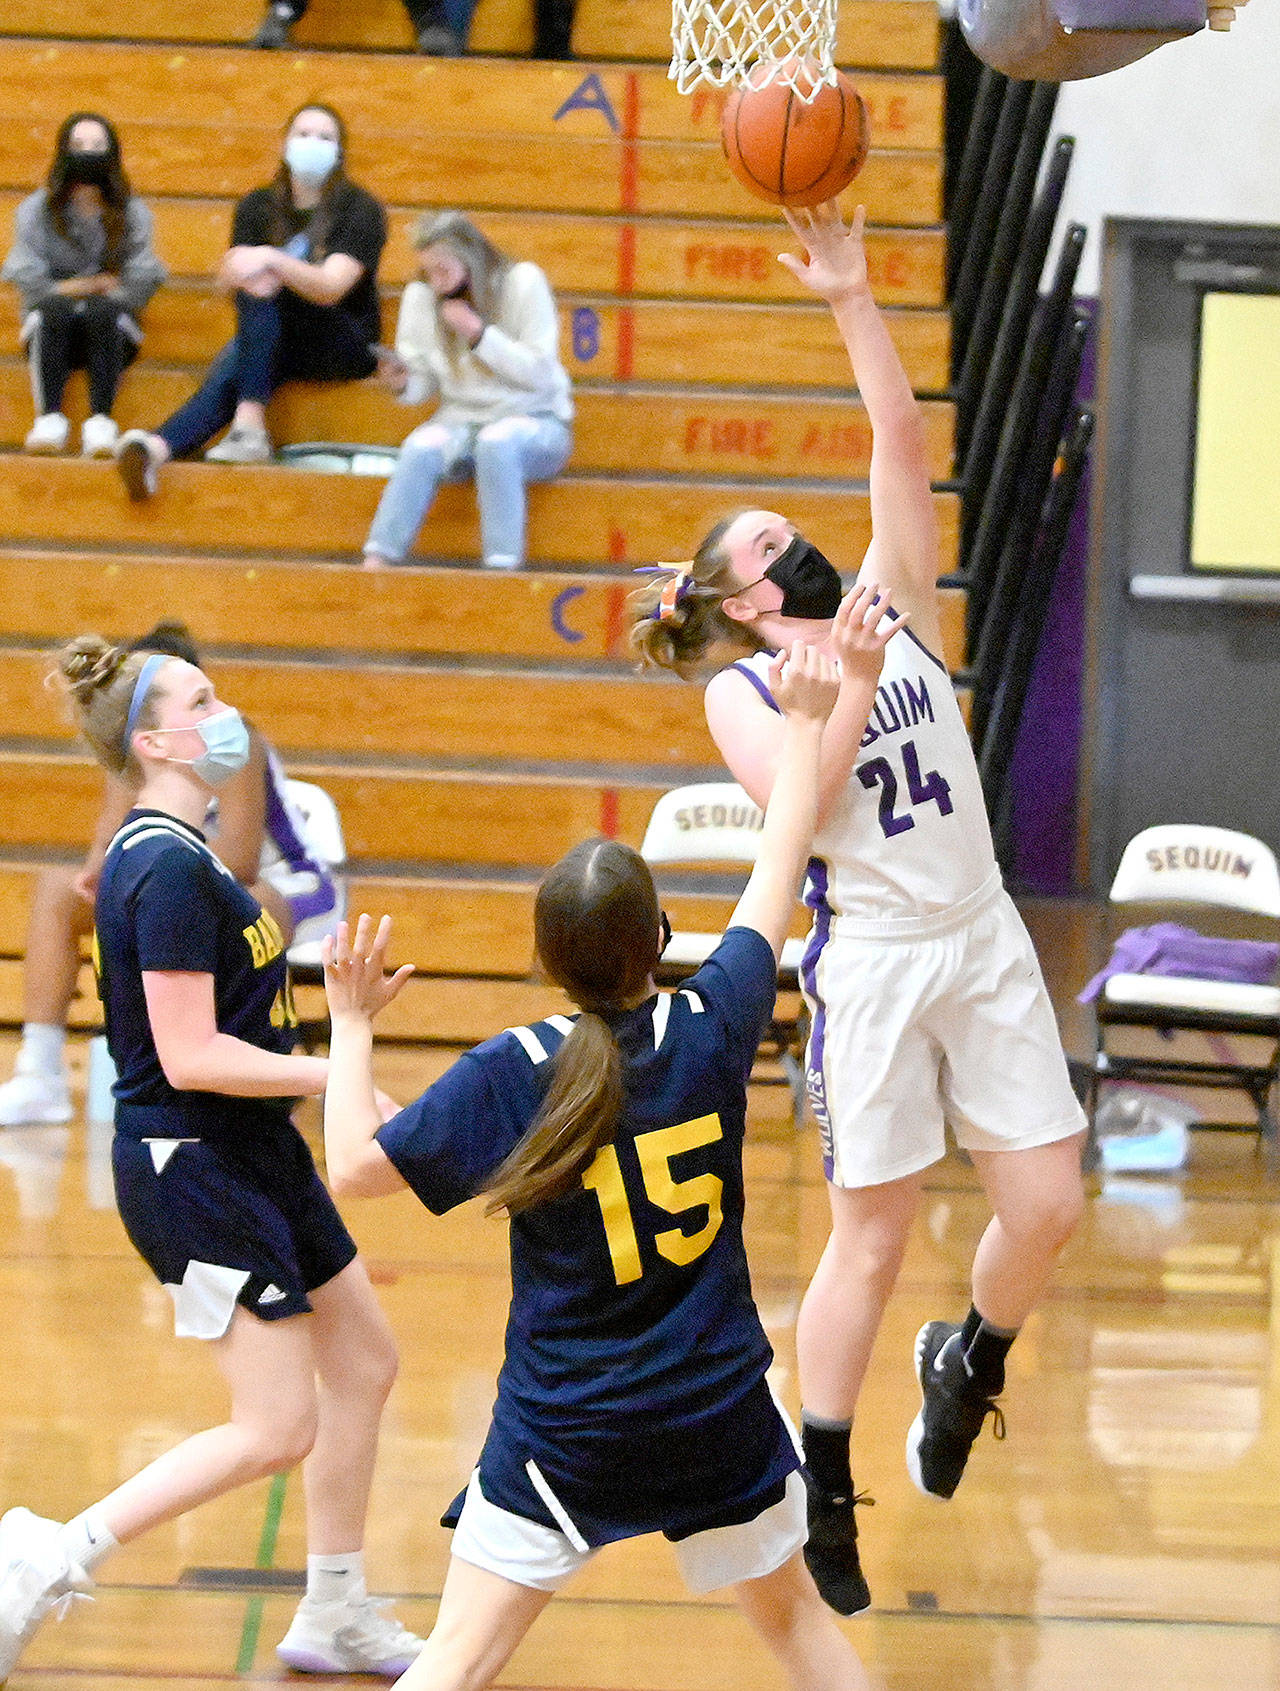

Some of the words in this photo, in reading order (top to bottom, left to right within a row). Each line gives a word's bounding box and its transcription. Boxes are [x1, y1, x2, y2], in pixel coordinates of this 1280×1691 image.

[553, 73, 622, 133] A
[684, 416, 775, 457] FIRE
[801, 422, 873, 459] AIS
[551, 586, 585, 643] C
[856, 740, 954, 838] 24
[1146, 846, 1253, 879] SEQUIM
[806, 1068, 834, 1157] WOLVES
[581, 1112, 724, 1286] 15
